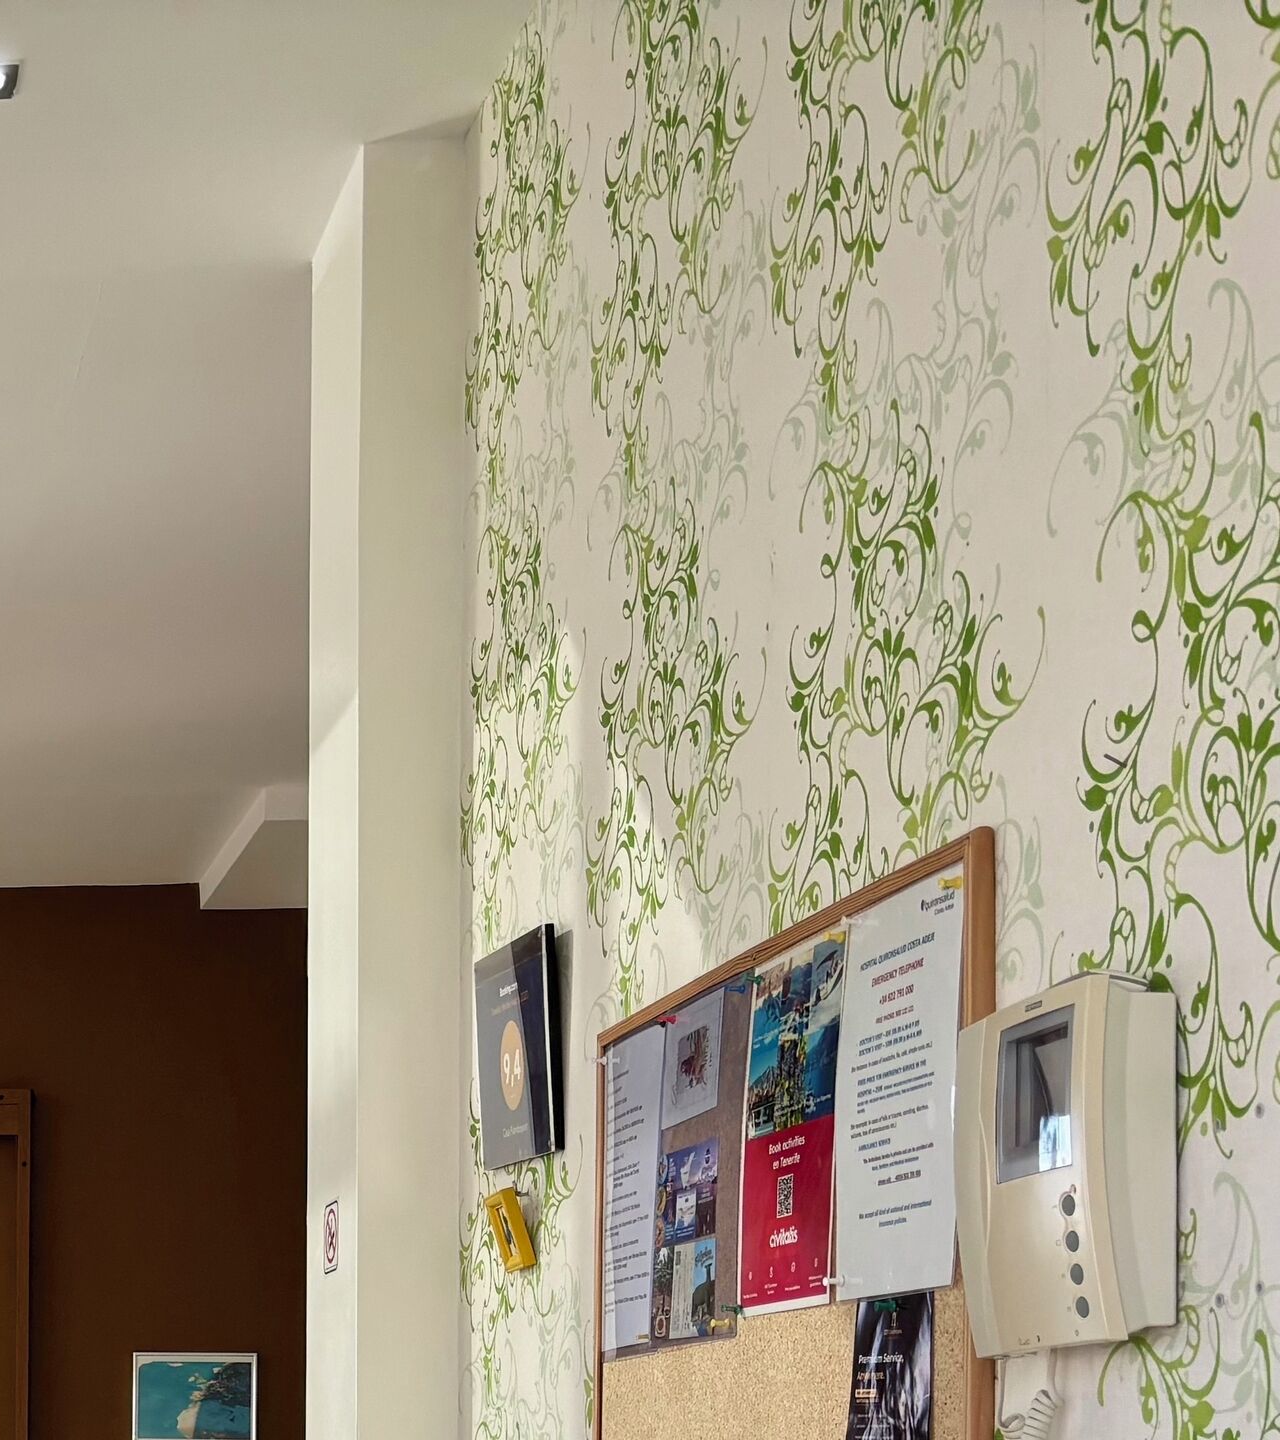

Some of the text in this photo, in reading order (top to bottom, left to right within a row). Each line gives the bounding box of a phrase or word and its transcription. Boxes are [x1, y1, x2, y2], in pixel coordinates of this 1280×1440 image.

[768, 1142, 782, 1155] Book
[780, 1153, 801, 1168] Tenerife
[769, 1226, 798, 1248] civitatis
